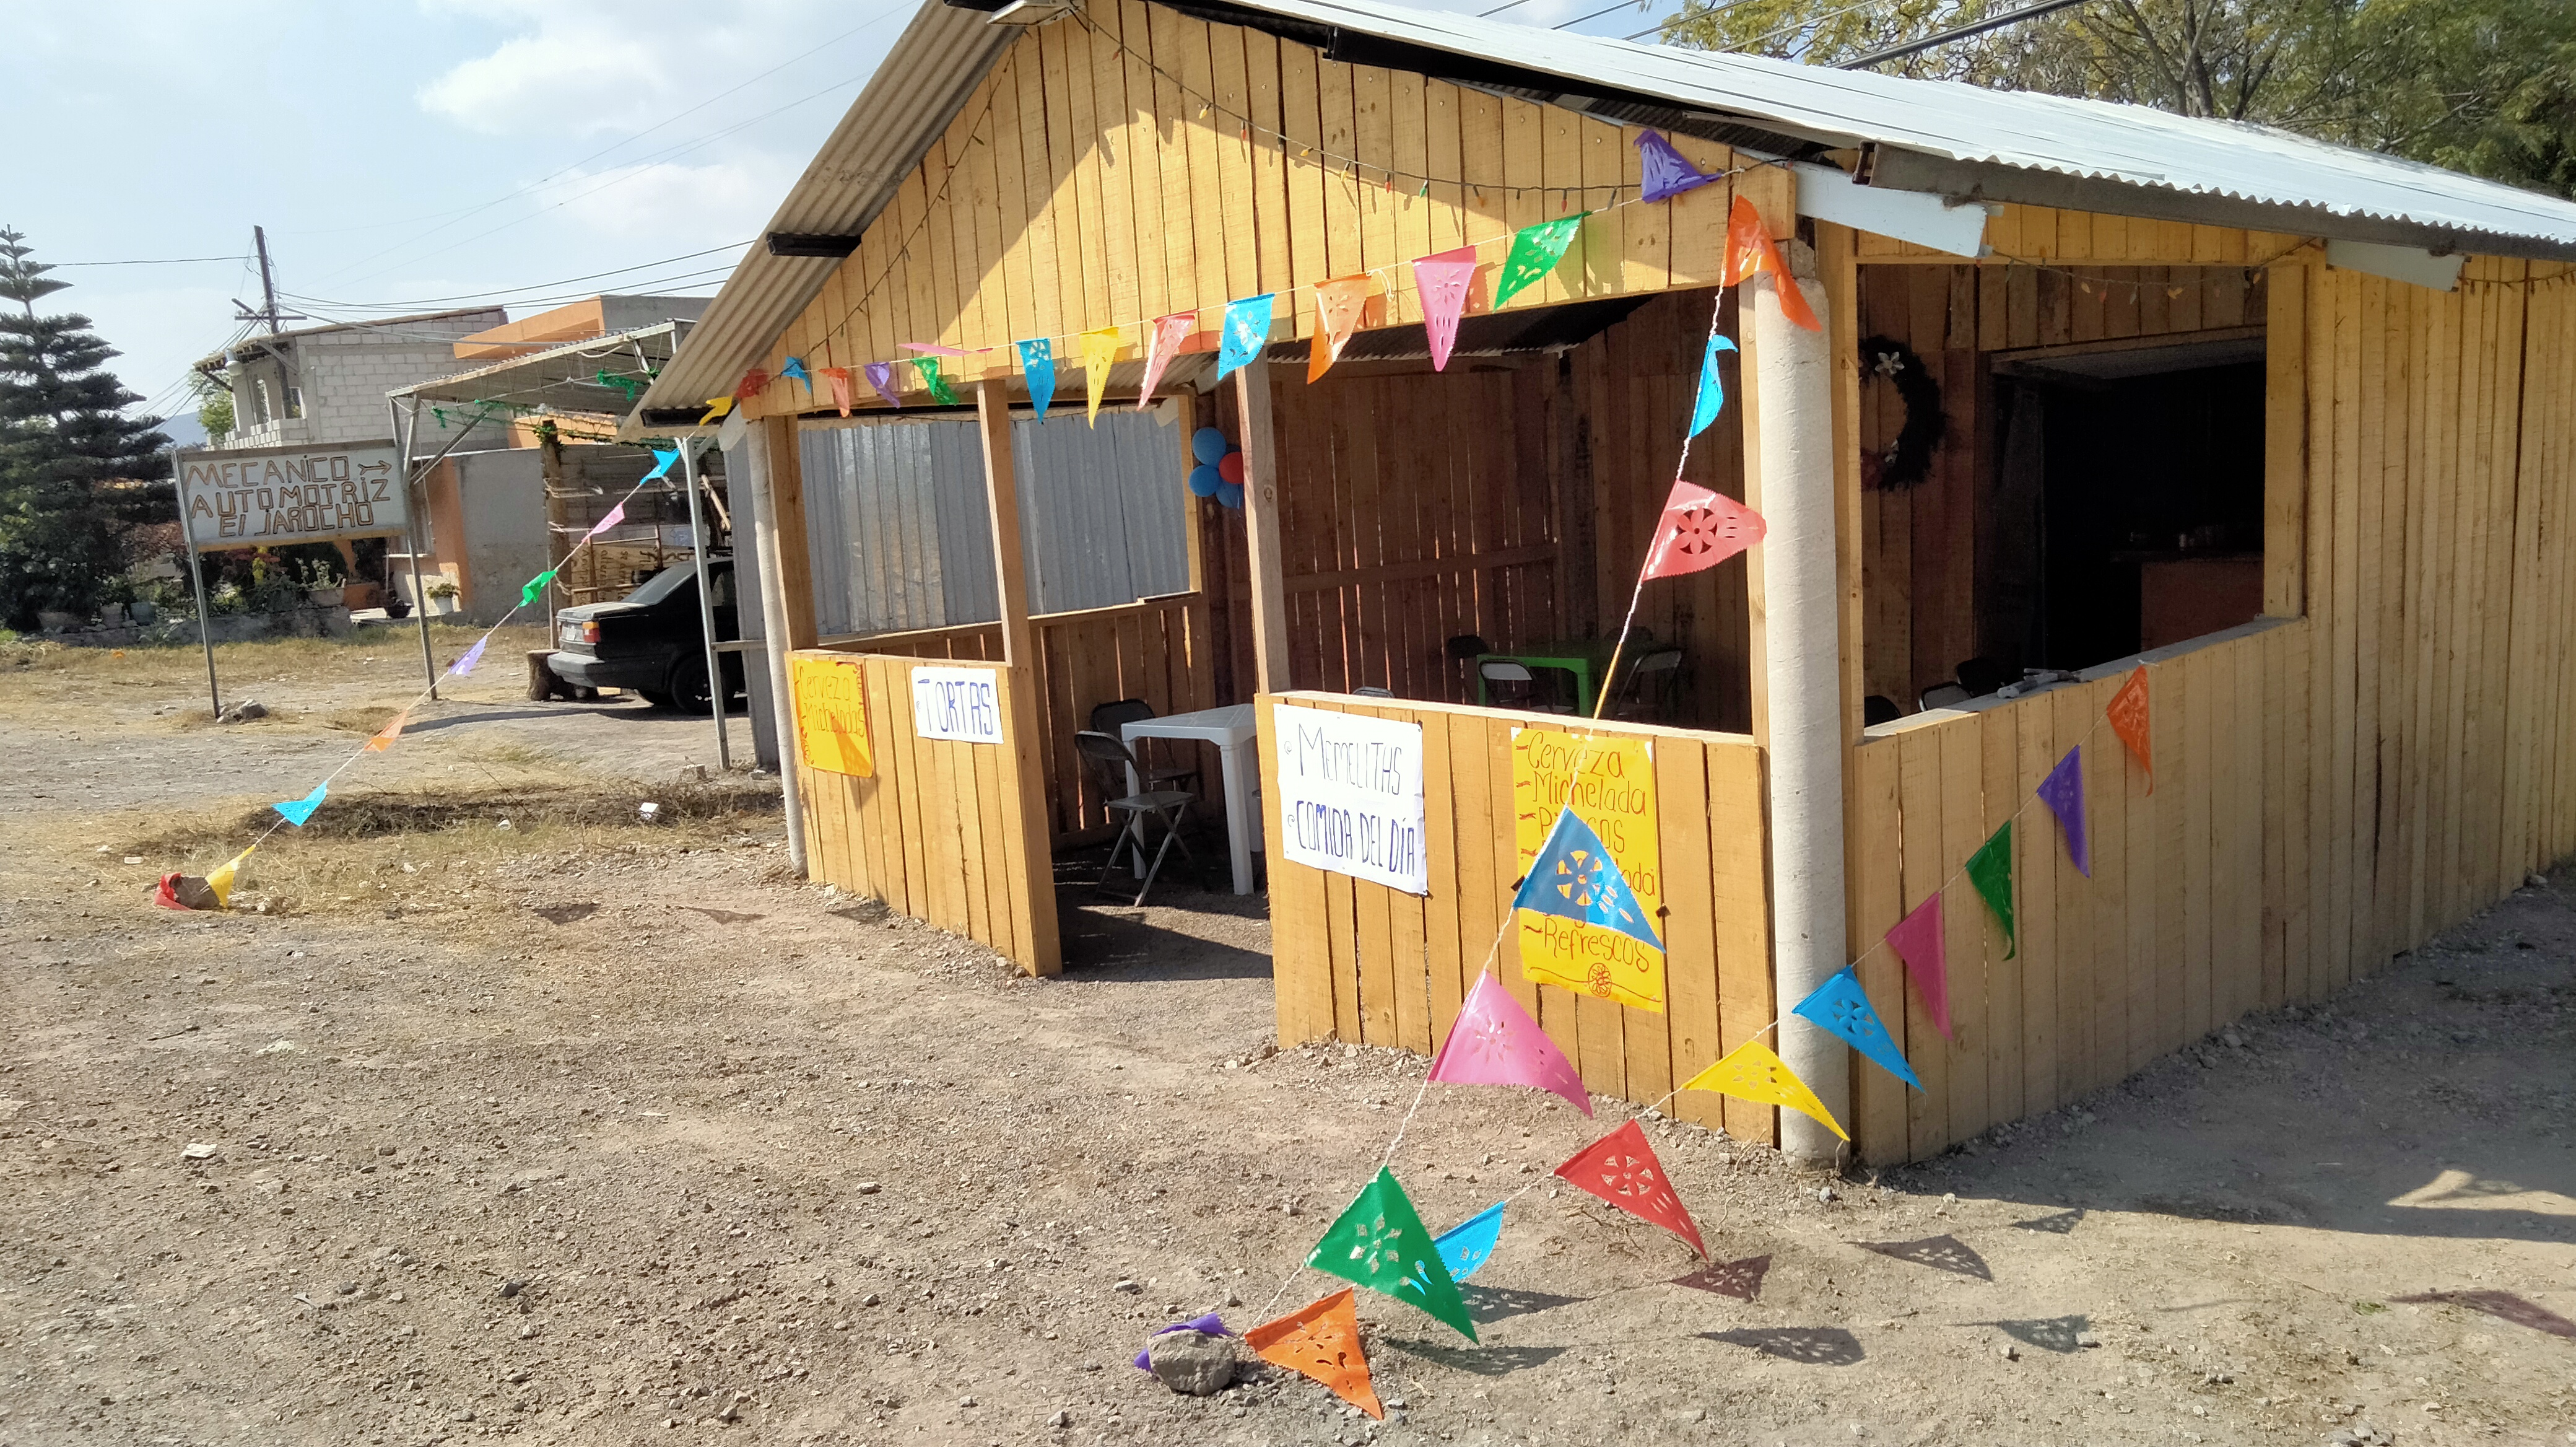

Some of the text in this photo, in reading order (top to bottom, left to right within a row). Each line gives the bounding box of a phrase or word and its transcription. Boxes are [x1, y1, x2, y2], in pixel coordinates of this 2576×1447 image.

[799, 666, 851, 702] Cerveza
[918, 678, 994, 735] TORTAS
[1528, 732, 1625, 779] Cerveza
[1532, 770, 1647, 817] Michelada
[1296, 800, 1353, 860] COMIDA
[1360, 812, 1383, 867] DEL
[1544, 917, 1650, 973] Refrescos
